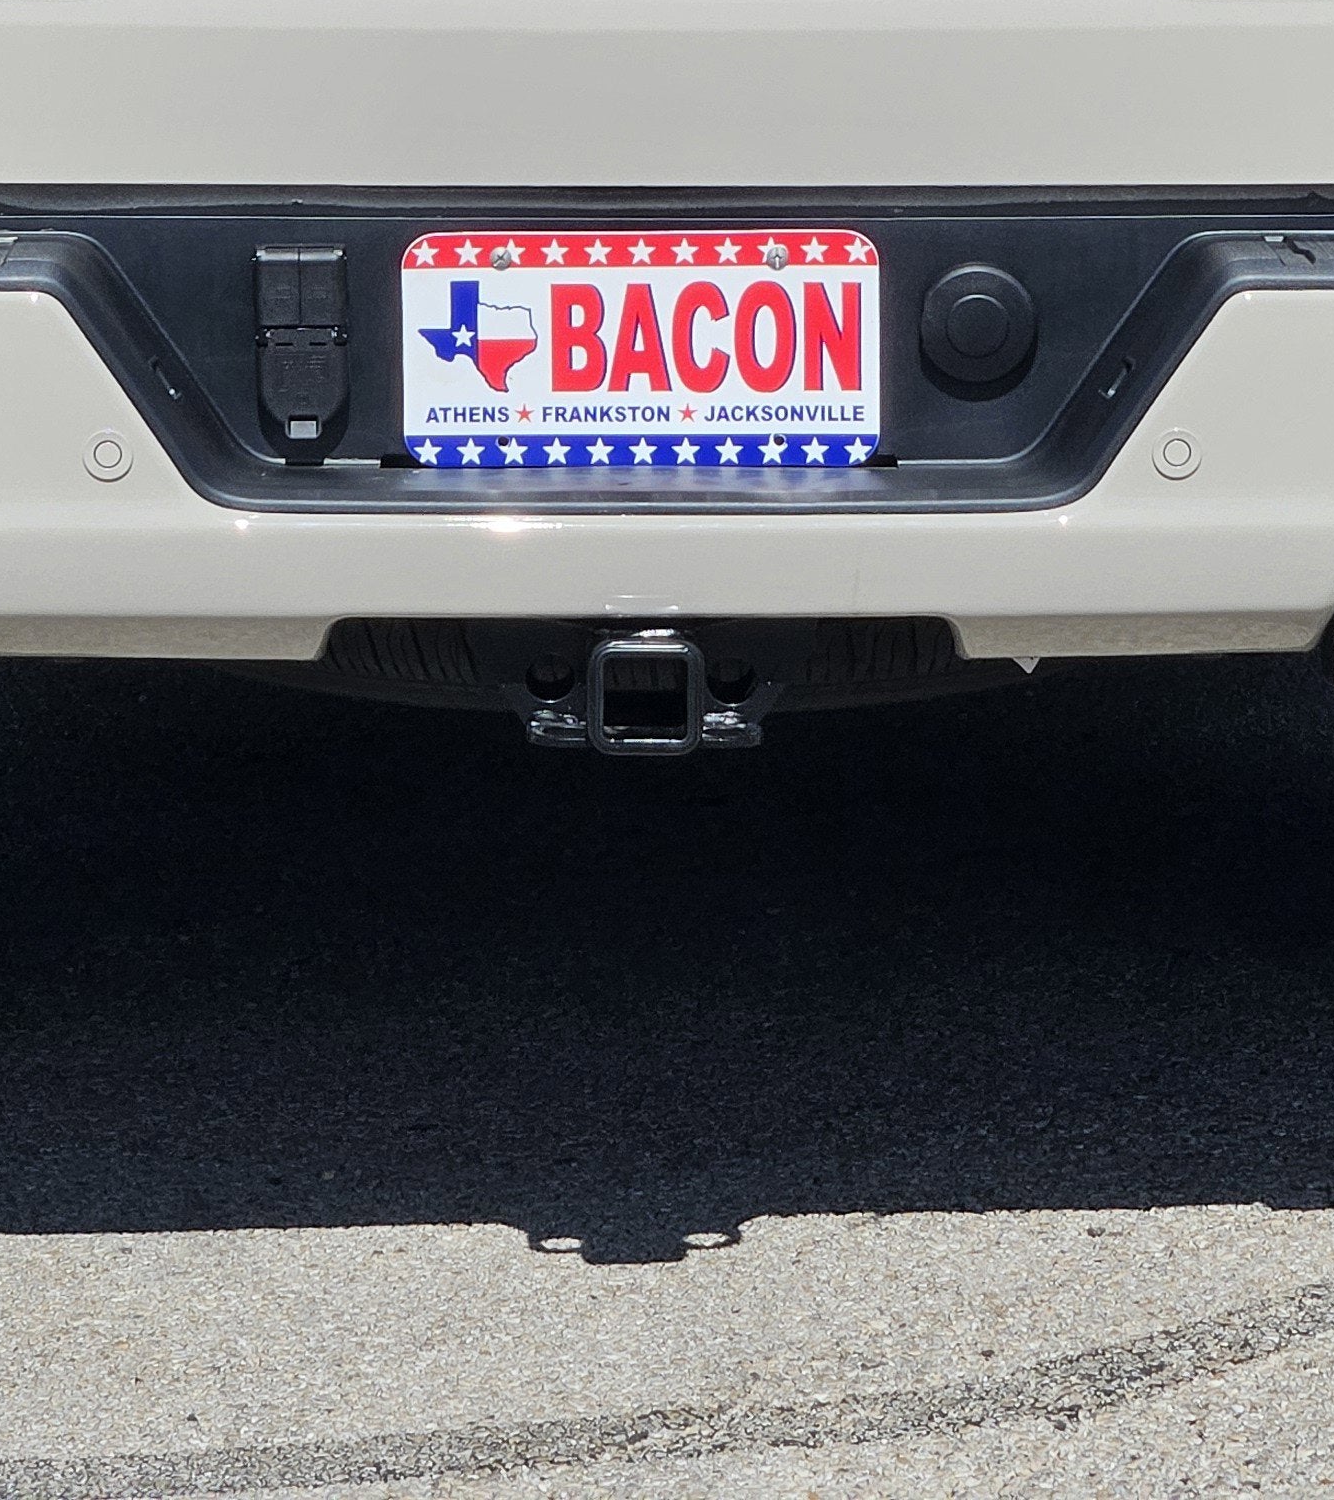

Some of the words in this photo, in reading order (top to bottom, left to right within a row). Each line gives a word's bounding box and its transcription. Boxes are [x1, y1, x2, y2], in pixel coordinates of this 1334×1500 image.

[550, 280, 862, 393] BACON
[426, 406, 510, 423] ATHENS
[542, 406, 670, 423] FRANKSTON
[704, 405, 865, 422] JACKSONVILLE
